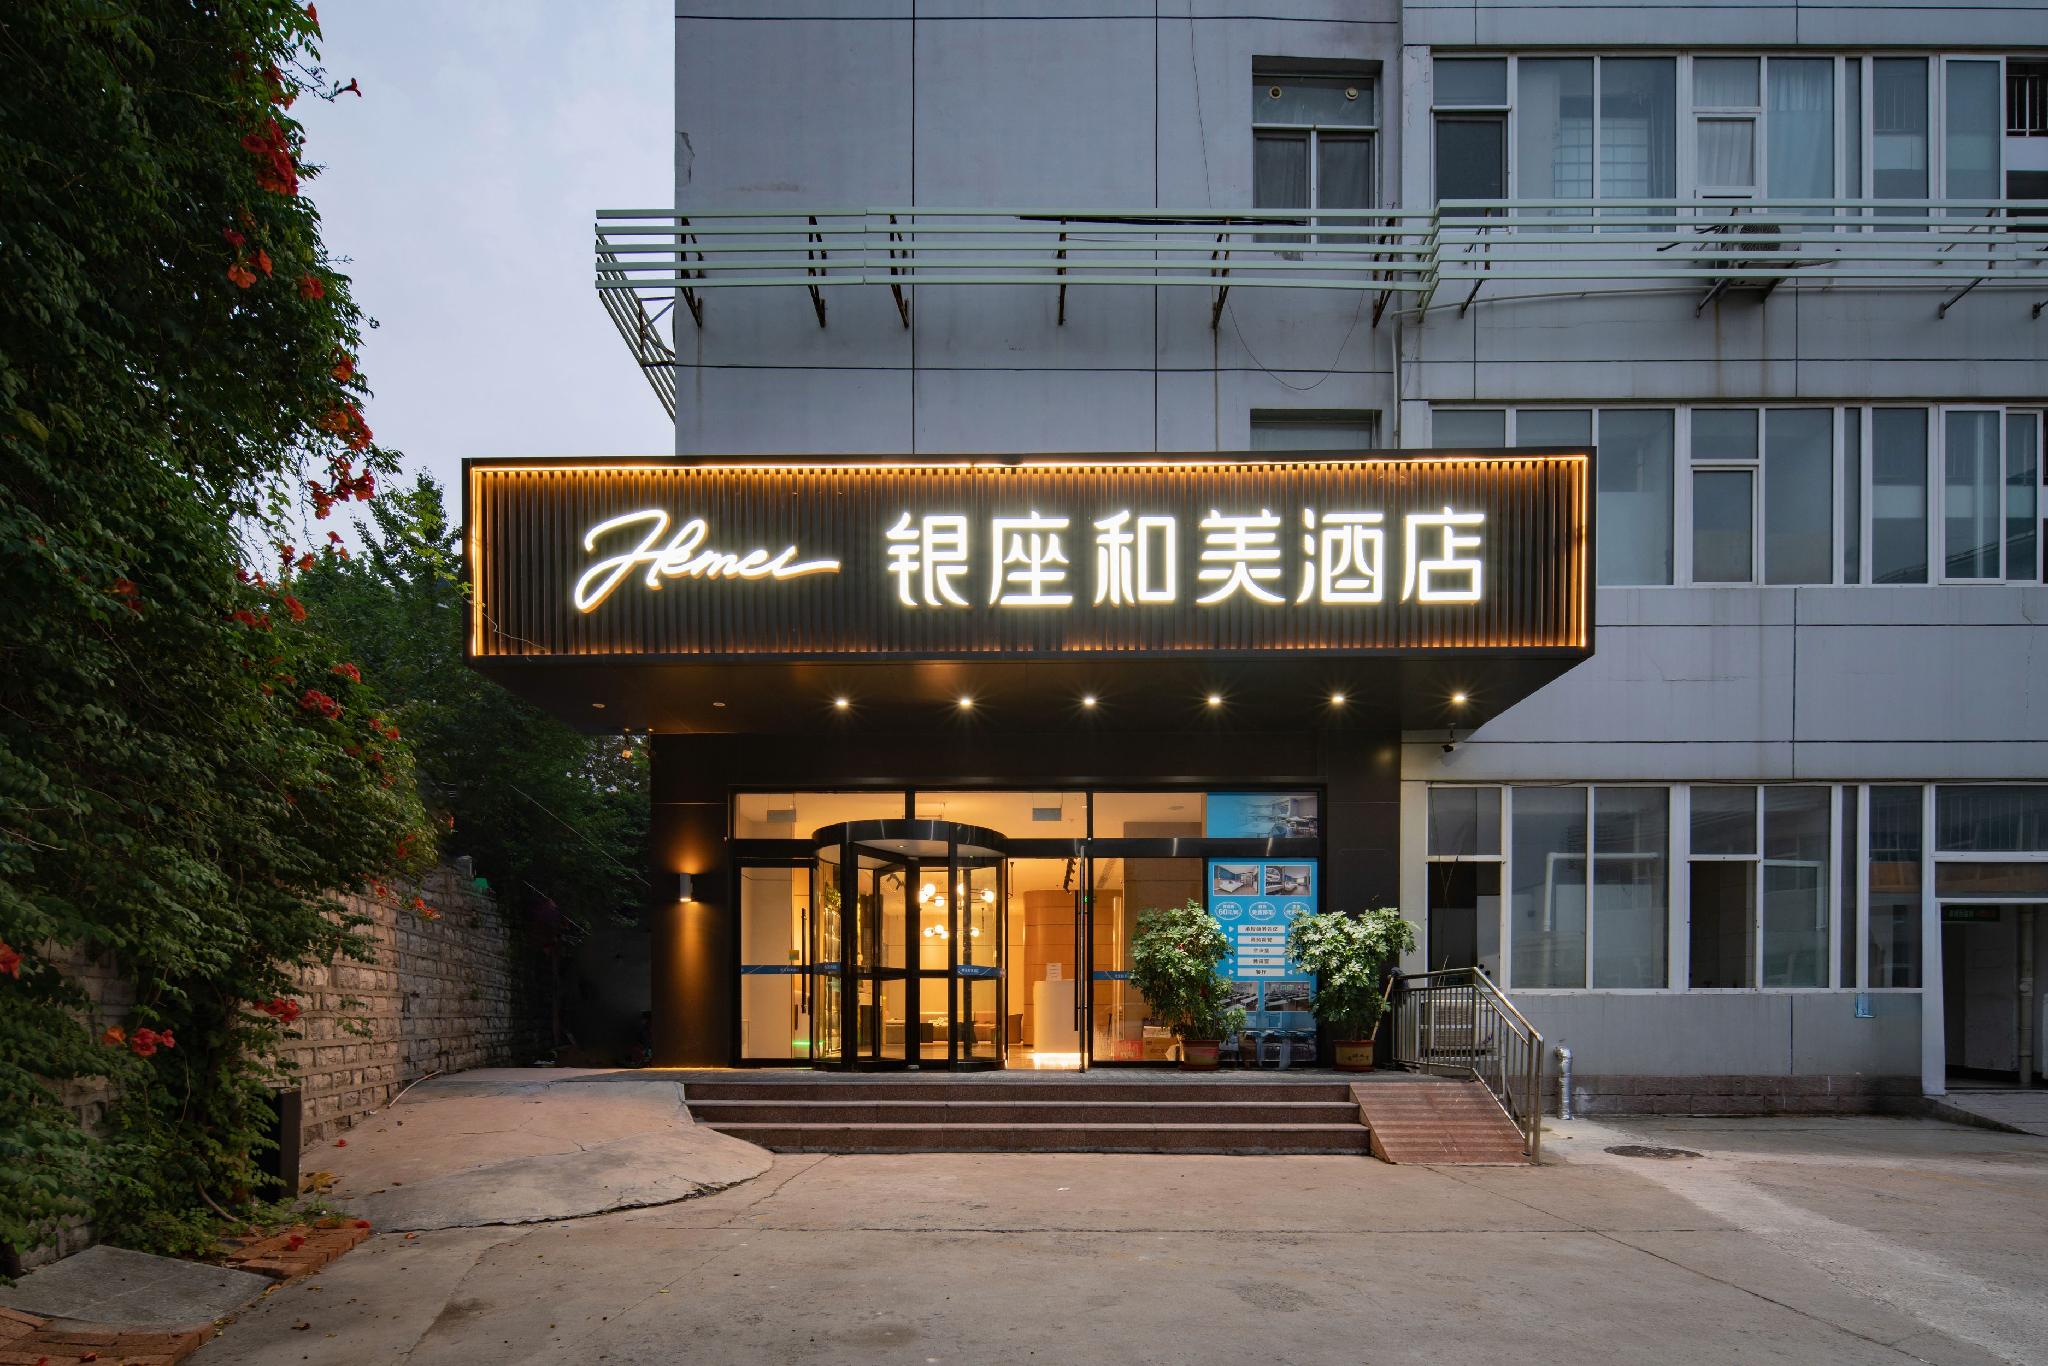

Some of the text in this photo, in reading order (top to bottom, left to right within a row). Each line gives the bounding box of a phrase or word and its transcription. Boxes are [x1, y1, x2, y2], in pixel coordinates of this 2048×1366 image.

[574, 508, 842, 613] Hemei
[884, 506, 1486, 608] 银座和美酒店
